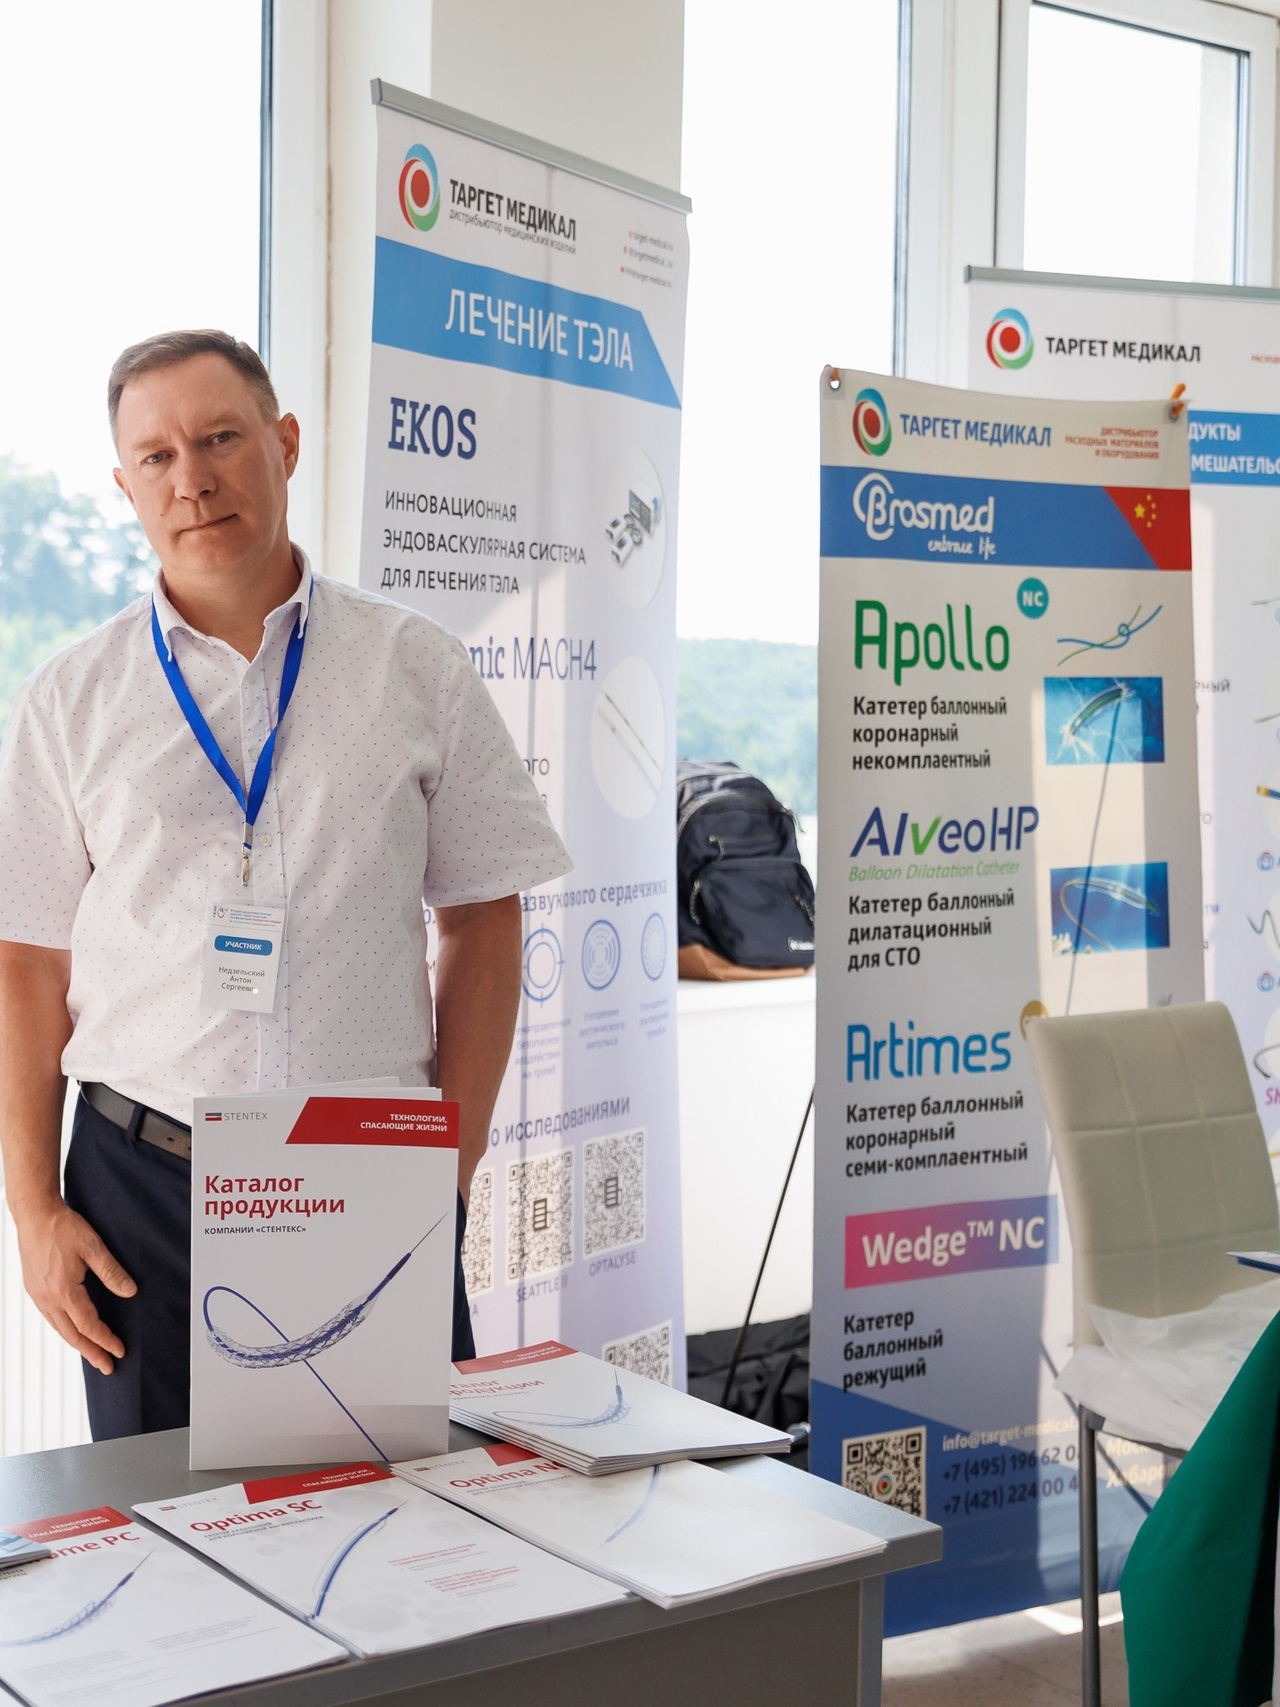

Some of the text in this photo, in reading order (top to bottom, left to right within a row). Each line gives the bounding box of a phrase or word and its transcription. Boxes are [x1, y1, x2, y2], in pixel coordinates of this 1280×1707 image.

[449, 208, 502, 235] дистрибьютор
[450, 179, 576, 241] ТАРГЕТ МЕДИКАЛ
[445, 288, 633, 372] ЛЕЧЕНИЕ ТЭЛА
[1046, 337, 1201, 363] ТАРГЕТ МЕДИКАЛ
[388, 397, 477, 460] EKOS
[900, 414, 1051, 448] ТАРГЕТ МЕДИКАЛ
[1188, 421, 1241, 442] ДУКТЫ
[385, 489, 516, 523] ИННОВАЦИОННАЯ
[852, 472, 995, 541] Brosmed
[383, 529, 586, 565] ЭНДОВАСКУЛЯРНАЯ СИСТЕМА
[381, 568, 520, 595] ДЛЯ ЛЕЧЕНИЯ ТЭЛА
[1022, 590, 1044, 608] NC
[854, 599, 1010, 686] Apollo
[514, 637, 596, 680] MACH4
[853, 696, 1007, 720] Катетер баллонный
[852, 722, 958, 748] коронарный
[852, 749, 991, 771] некомплаентный
[849, 858, 1020, 884] Balloon Dilatation Catheter
[600, 879, 667, 906] сердечника
[849, 888, 1015, 917] Катетер баллонный
[848, 917, 992, 946] дилатационный
[225, 940, 262, 951] УЧАСТНИК
[848, 946, 920, 972] для СТО
[219, 966, 265, 977] Недзельский
[230, 975, 252, 983] Антон
[221, 982, 258, 992] Сергееви
[846, 1020, 1011, 1083] Artimes
[224, 1112, 268, 1121] STENTEX
[390, 1113, 447, 1124] ТЕХНОЛОГИИ,
[505, 1097, 630, 1143] исследованиями
[846, 1090, 1024, 1124] Катетер баллонный
[360, 1122, 447, 1132] СПАСАЮЩИЕ ЖИЗНИ
[845, 1121, 955, 1152] коронарный
[845, 1142, 1028, 1178] семи-комплаентный
[205, 1175, 304, 1193] Каталог
[205, 1198, 345, 1220] продукции
[205, 1225, 306, 1235] КОМПАНИИ «СТЕНТЕКС»
[999, 1216, 1045, 1252] NC
[589, 1252, 636, 1277] OPTALYSE
[516, 1279, 559, 1303] SEATTLE
[844, 1309, 914, 1335] Катетер
[843, 1329, 944, 1362] баллонный
[842, 1357, 927, 1393] режущий
[449, 1468, 536, 1488] Optima
[943, 1446, 1060, 1483] +7 (495) 196 62
[943, 1478, 1063, 1515] +7 (421) 224 00
[190, 1499, 323, 1533] Optima SC
[102, 1531, 141, 1546] PC
